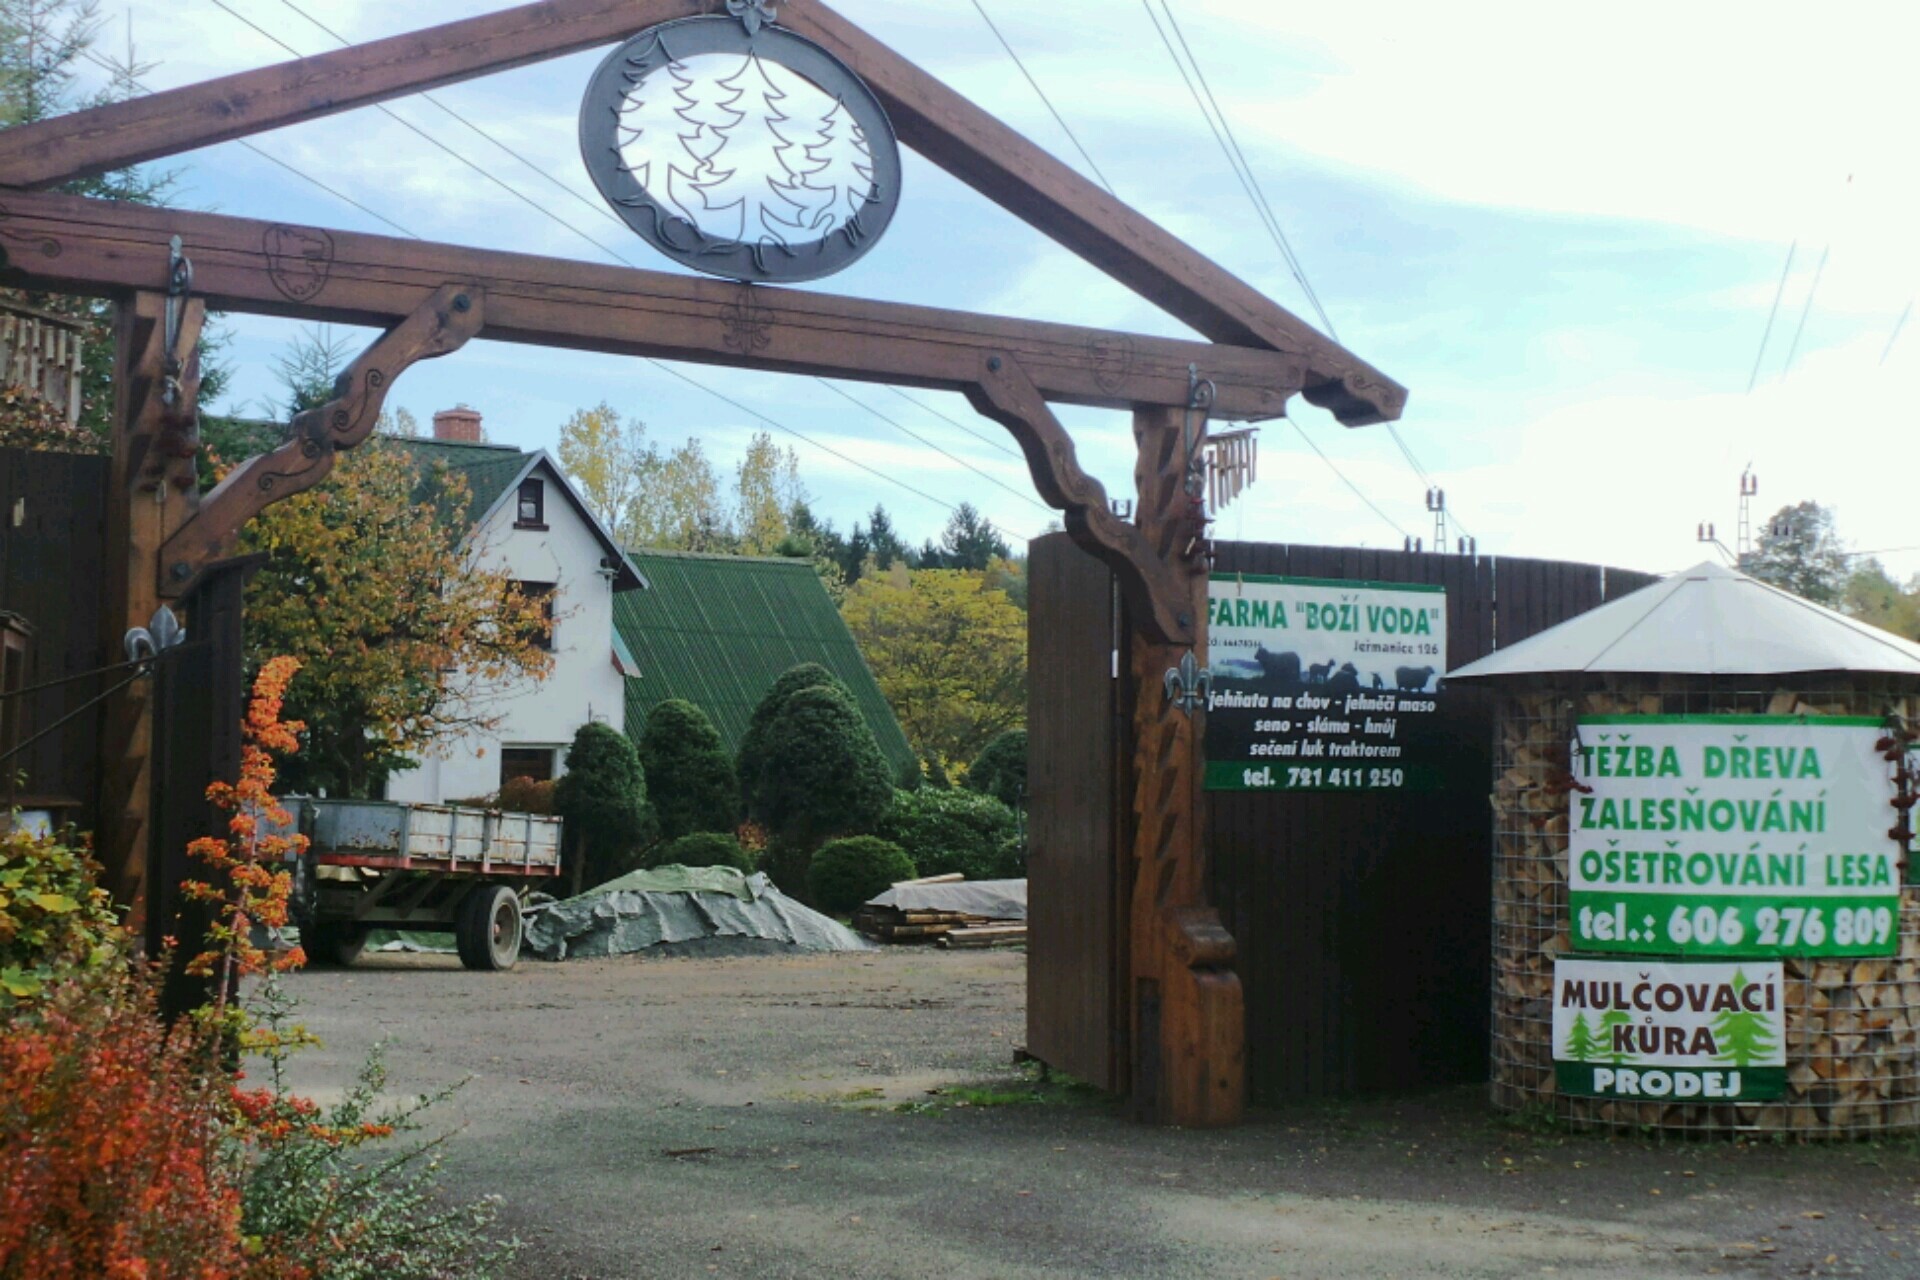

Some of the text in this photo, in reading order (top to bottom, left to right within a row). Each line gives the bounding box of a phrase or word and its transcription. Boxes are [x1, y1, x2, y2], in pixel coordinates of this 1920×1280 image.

[1417, 643, 1438, 655] 126
[1208, 690, 1268, 711] jehňata
[1272, 695, 1292, 709] na
[1296, 692, 1330, 710] chov
[1345, 695, 1395, 714] jehněčí
[1398, 699, 1436, 712] maso
[1254, 718, 1290, 731] seno
[1307, 716, 1350, 732] sláma
[1365, 717, 1395, 738] hnůj
[1250, 739, 1401, 757] sečení luk traktorem
[1580, 734, 1821, 779] TĚŽBA DŘEVA
[1243, 766, 1403, 787] tel. 721 411 250
[1580, 786, 1827, 833] ZALESŇOVÁNÍ
[1579, 839, 1890, 887] OŠETŘOVÁNÍ LESA
[1578, 903, 1892, 946] tel.: 606 276 809
[1561, 972, 1775, 1012] MULČOVACÍ
[1613, 1016, 1718, 1055] KŮRA
[1593, 1067, 1741, 1098] PRODEJ
